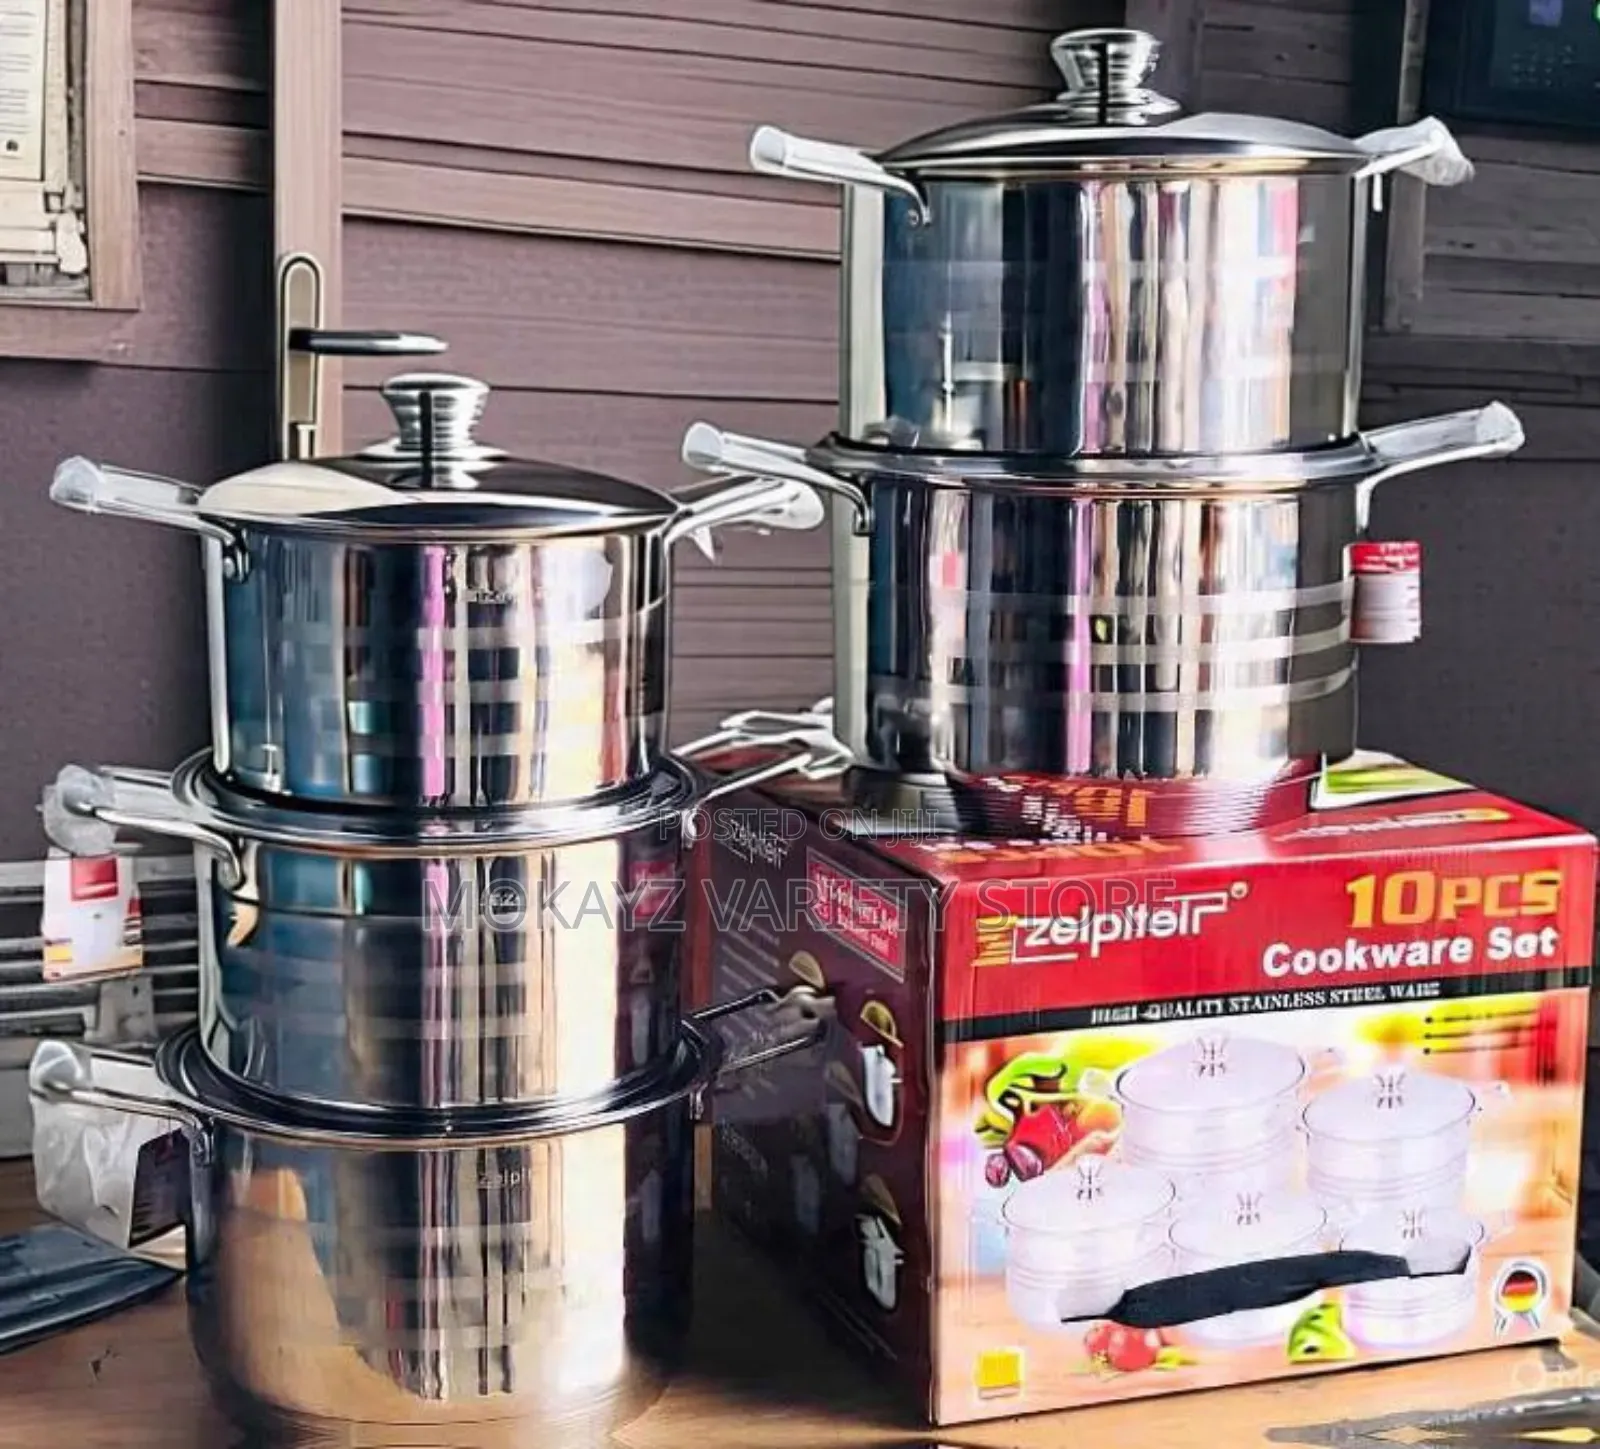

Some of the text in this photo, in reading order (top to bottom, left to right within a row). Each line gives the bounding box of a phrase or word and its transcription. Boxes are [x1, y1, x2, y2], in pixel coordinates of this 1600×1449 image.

[1346, 870, 1563, 928] 10PCS
[1262, 926, 1560, 978] Cookware Set
[1228, 990, 1326, 1013] STAINLESS
[1330, 986, 1386, 1005] STEEL
